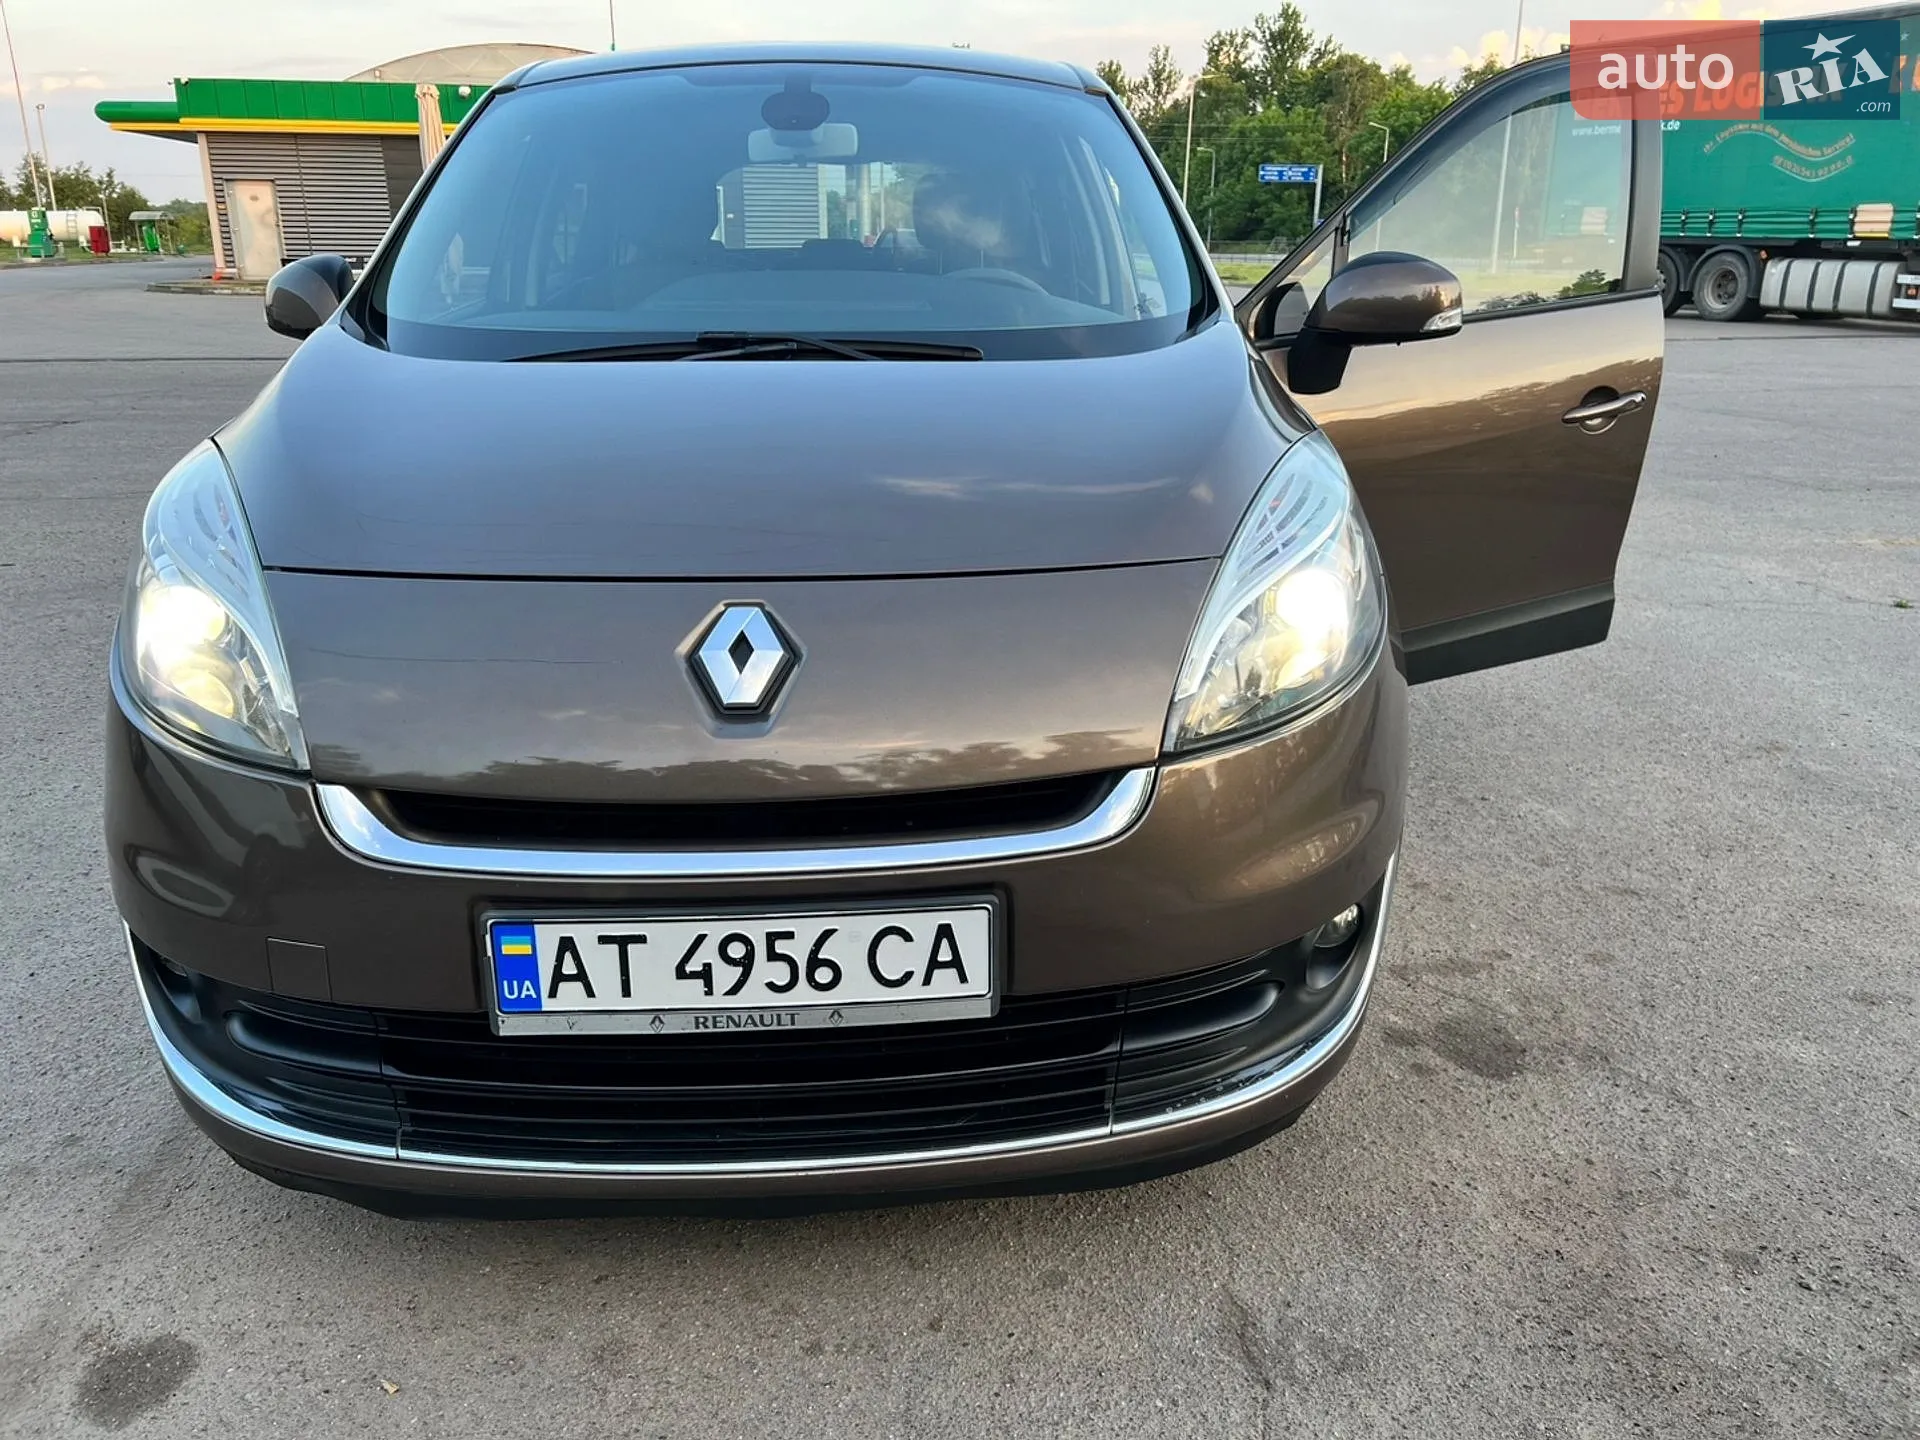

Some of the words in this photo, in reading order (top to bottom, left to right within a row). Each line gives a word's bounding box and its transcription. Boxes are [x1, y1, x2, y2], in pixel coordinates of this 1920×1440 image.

[547, 934, 648, 999] AT
[675, 928, 843, 997] 4956
[867, 922, 970, 989] CA
[503, 980, 537, 999] UA
[693, 1012, 800, 1030] RENAULT
